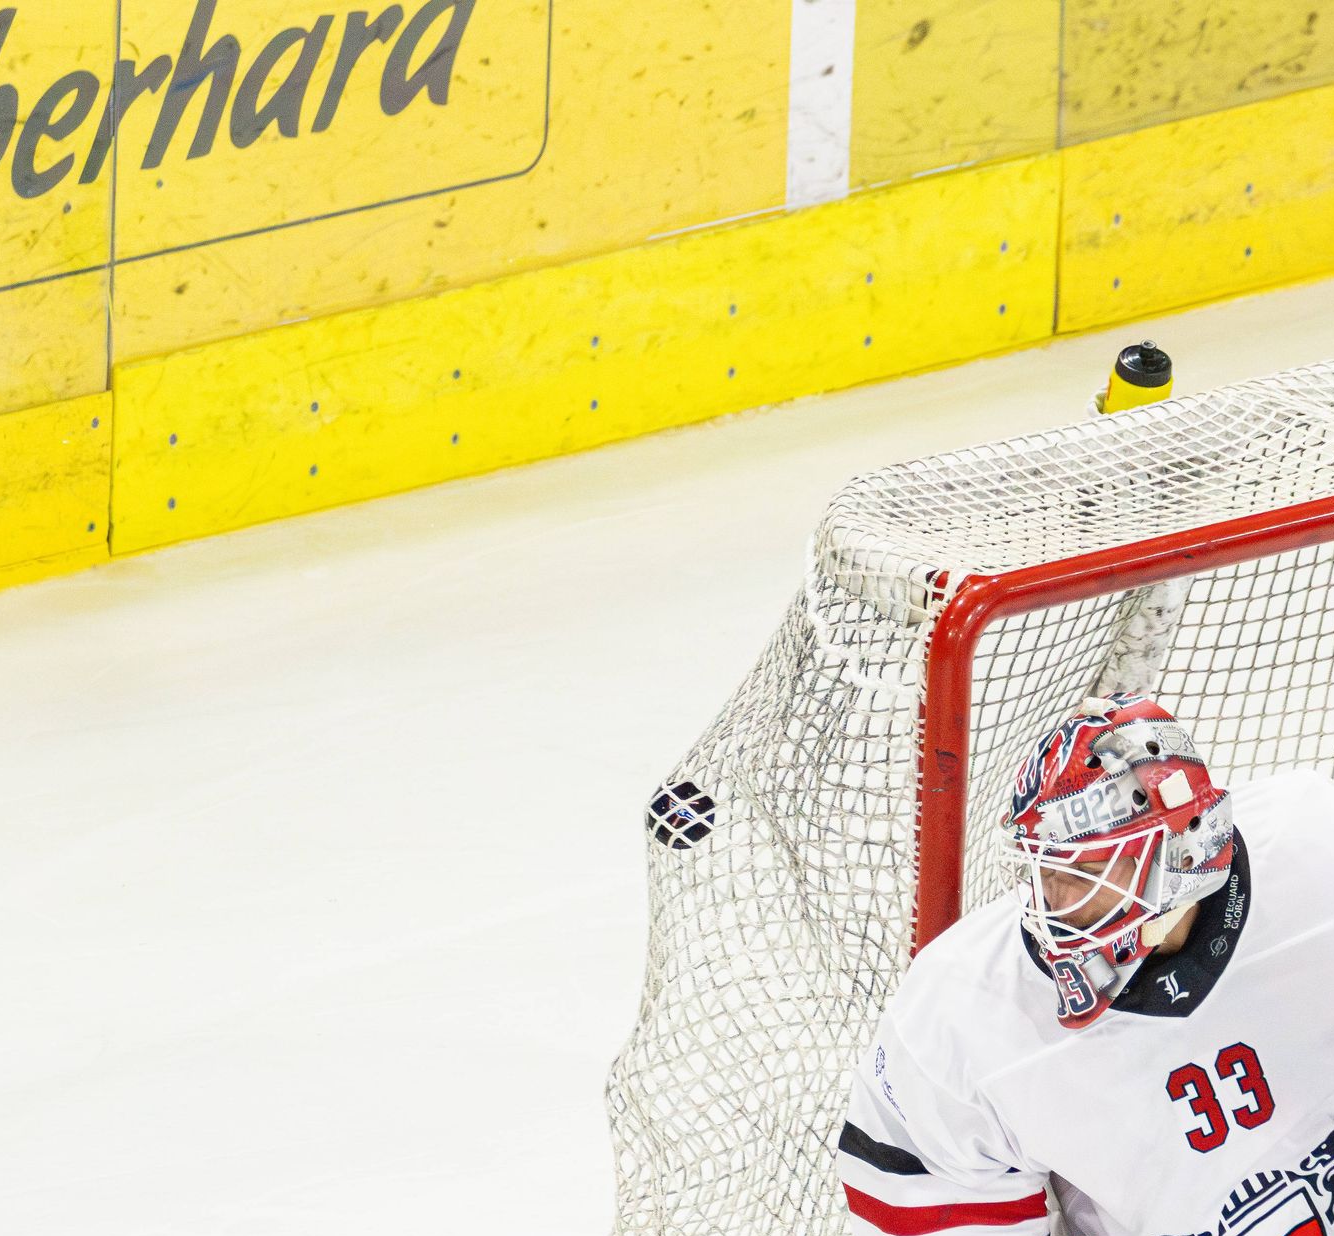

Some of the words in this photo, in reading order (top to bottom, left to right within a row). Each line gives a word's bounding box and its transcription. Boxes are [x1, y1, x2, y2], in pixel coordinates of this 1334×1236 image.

[1056, 782, 1128, 835] 1922
[1223, 874, 1239, 929] SAFEGUARD
[1231, 893, 1246, 930] GLOBAL
[1053, 960, 1097, 1018] 3
[1165, 1042, 1276, 1153] 33
